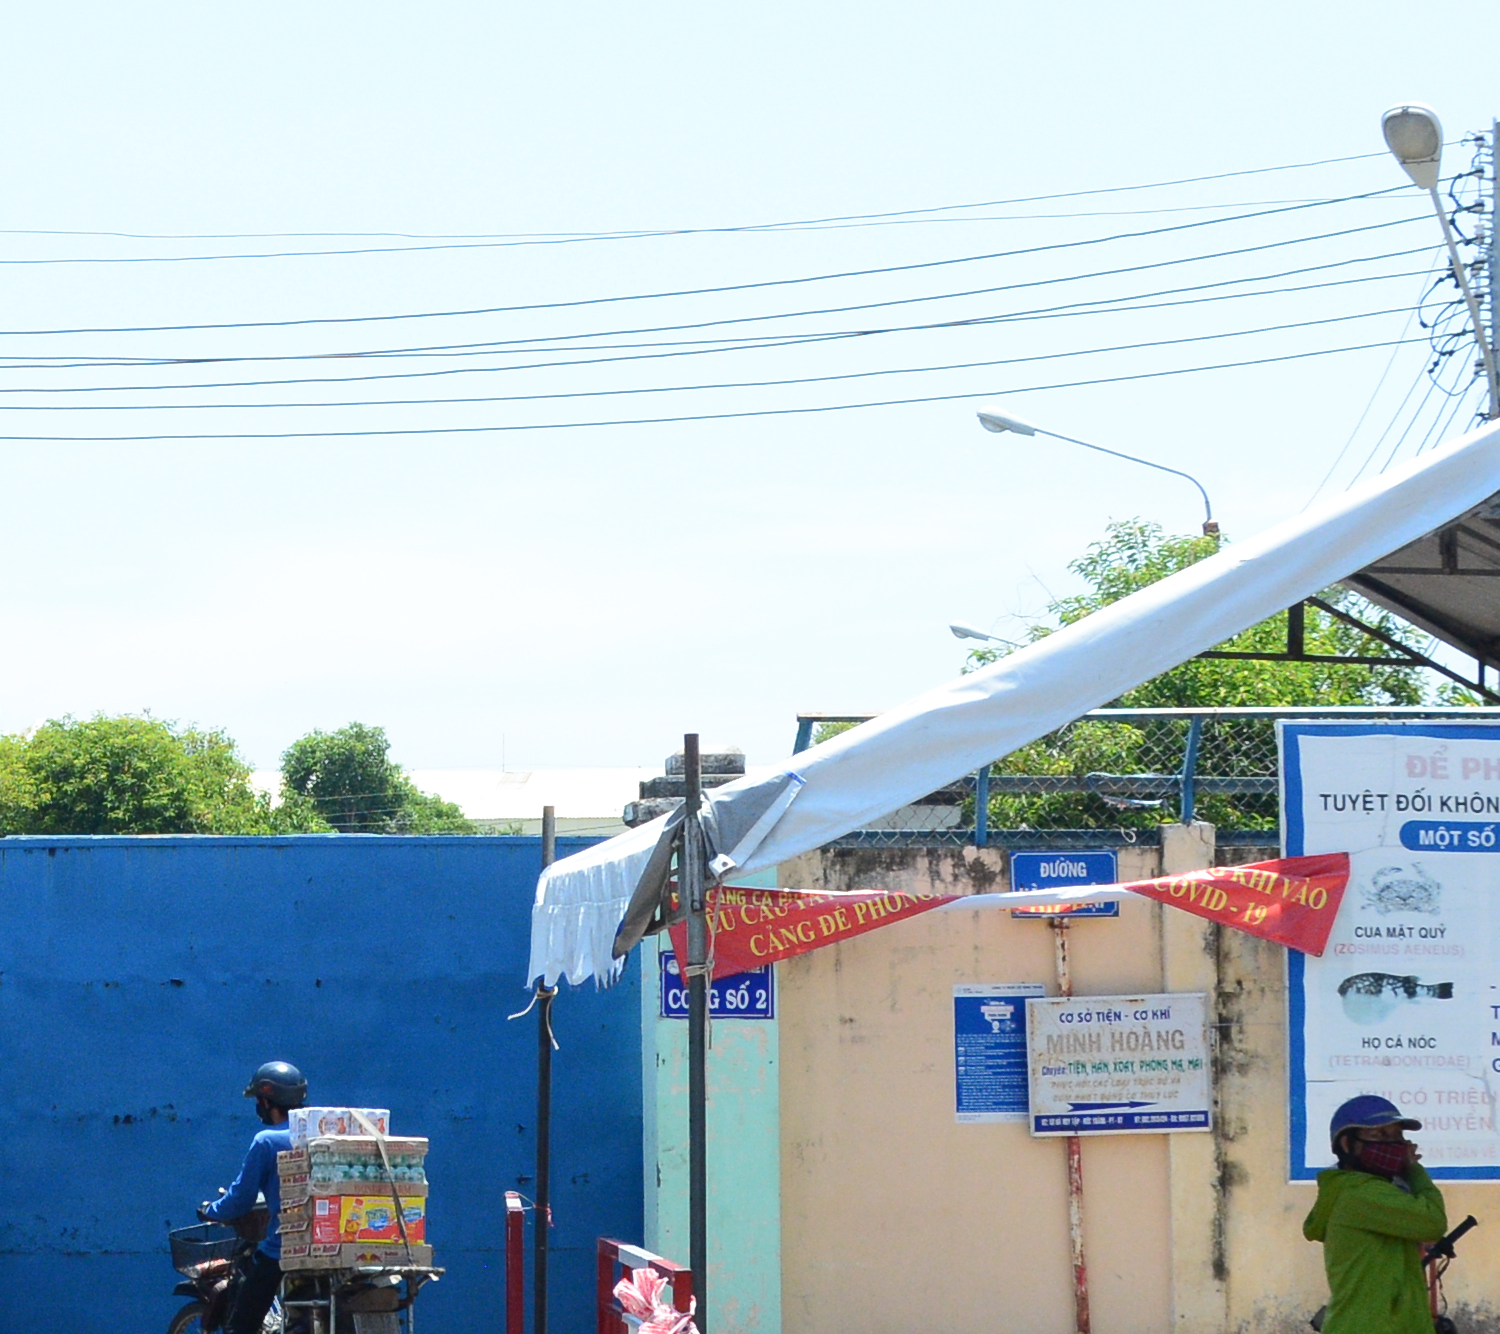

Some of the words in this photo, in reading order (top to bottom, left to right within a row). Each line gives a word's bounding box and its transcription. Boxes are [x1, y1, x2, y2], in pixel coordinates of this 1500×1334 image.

[1319, 790, 1388, 815] TUYỆT
[1396, 787, 1432, 812] ĐỐI
[1419, 827, 1462, 849] MỘT
[1468, 825, 1496, 847] SỐ
[1040, 856, 1087, 878] ĐƯỜNG
[1153, 876, 1228, 912] COVID
[1244, 900, 1268, 926] 19
[1234, 868, 1279, 896] KHI
[1281, 873, 1328, 910] VÀO
[749, 922, 815, 956] CẢNG
[1354, 926, 1382, 939] CUA
[1386, 923, 1415, 942] MẶT
[1418, 922, 1447, 940] QUỶ
[1334, 943, 1399, 956] (ZOSIMUS
[725, 980, 750, 1010] SỐ
[756, 988, 767, 1009] 2
[1059, 1012, 1075, 1023] CƠ
[1077, 1008, 1093, 1023] SỞ
[1095, 1009, 1122, 1025] TIỆN
[1151, 1006, 1171, 1020] KHÍ
[1046, 1030, 1101, 1054] MINH
[1110, 1026, 1185, 1053] HOÀNG
[1362, 1037, 1381, 1051] HỌ
[1385, 1035, 1403, 1049] CÁ
[1408, 1035, 1437, 1049] NÓC
[1400, 1087, 1427, 1104] CÓ
